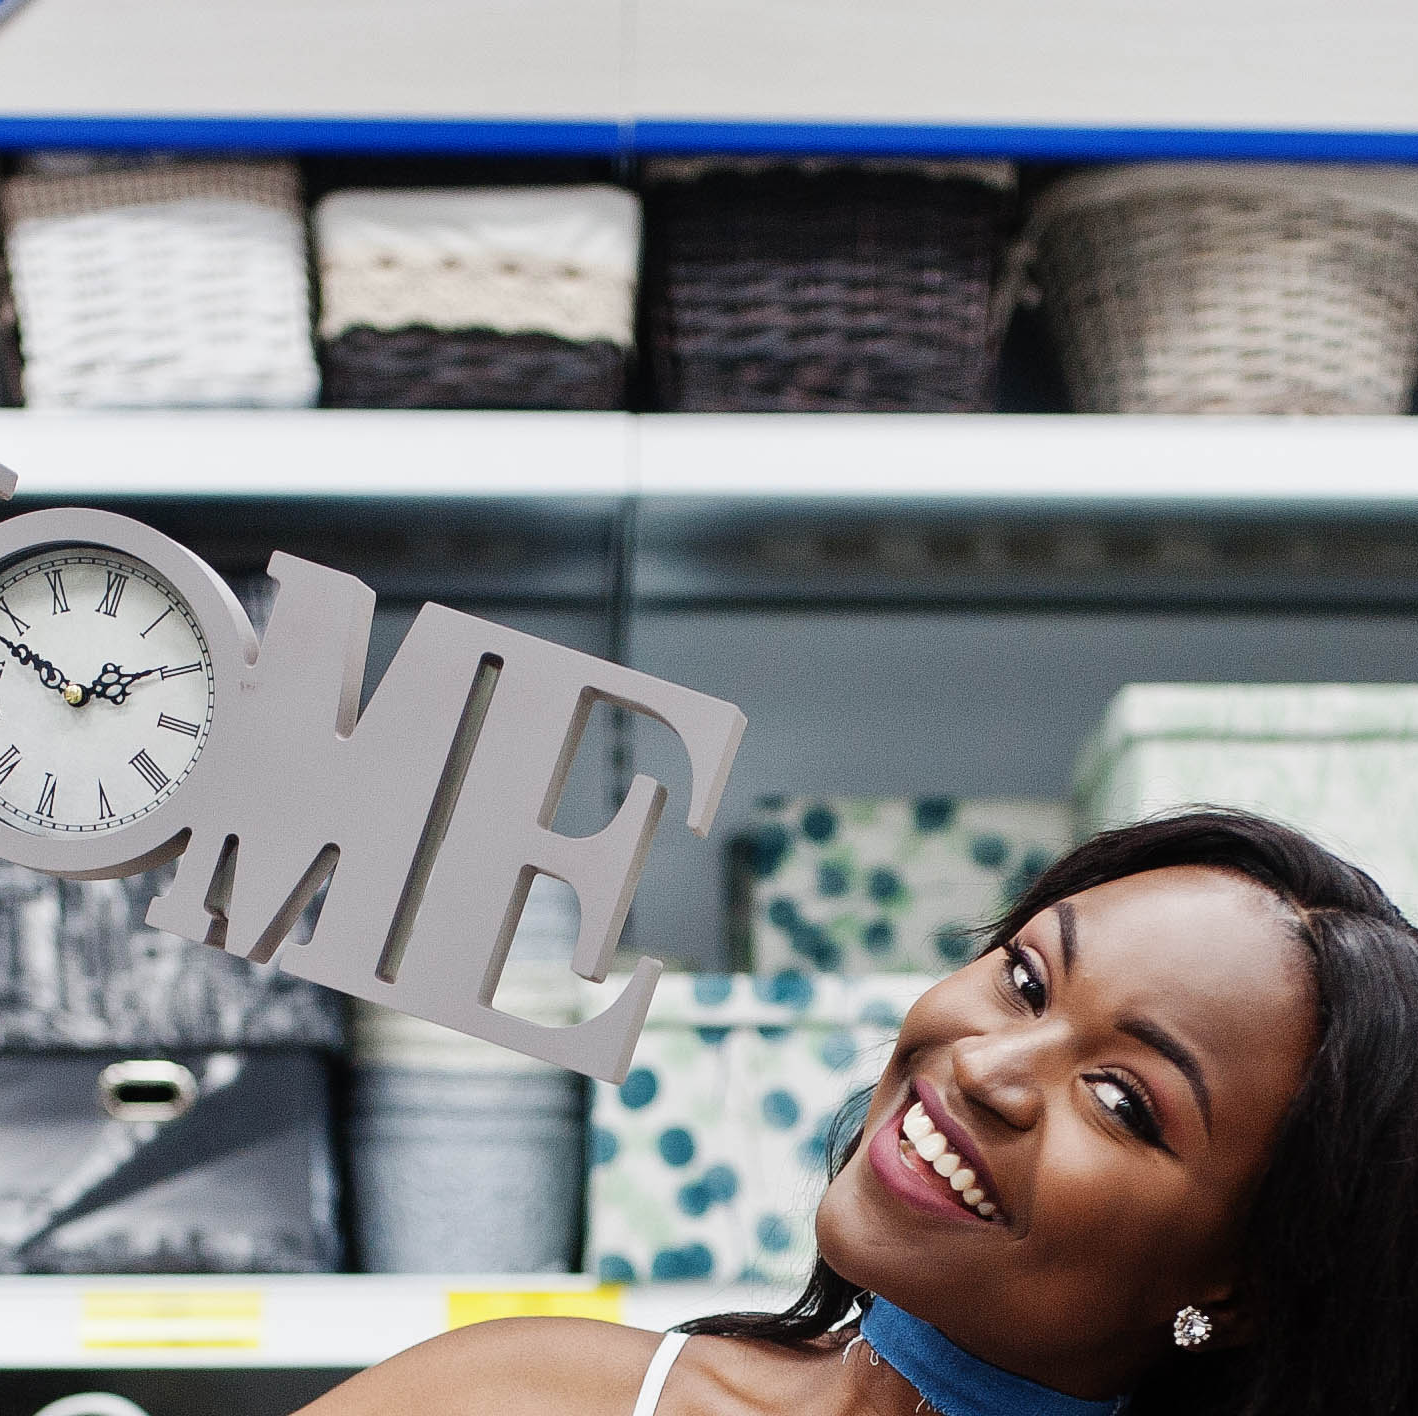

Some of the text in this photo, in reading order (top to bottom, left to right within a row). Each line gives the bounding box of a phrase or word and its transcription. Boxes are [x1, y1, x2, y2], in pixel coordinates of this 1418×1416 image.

[45, 568, 71, 616] XI
[94, 570, 129, 618] XII
[139, 604, 175, 639] I
[160, 660, 203, 681] II
[156, 712, 201, 739] III
[34, 772, 58, 818] VI
[97, 776, 116, 820] V
